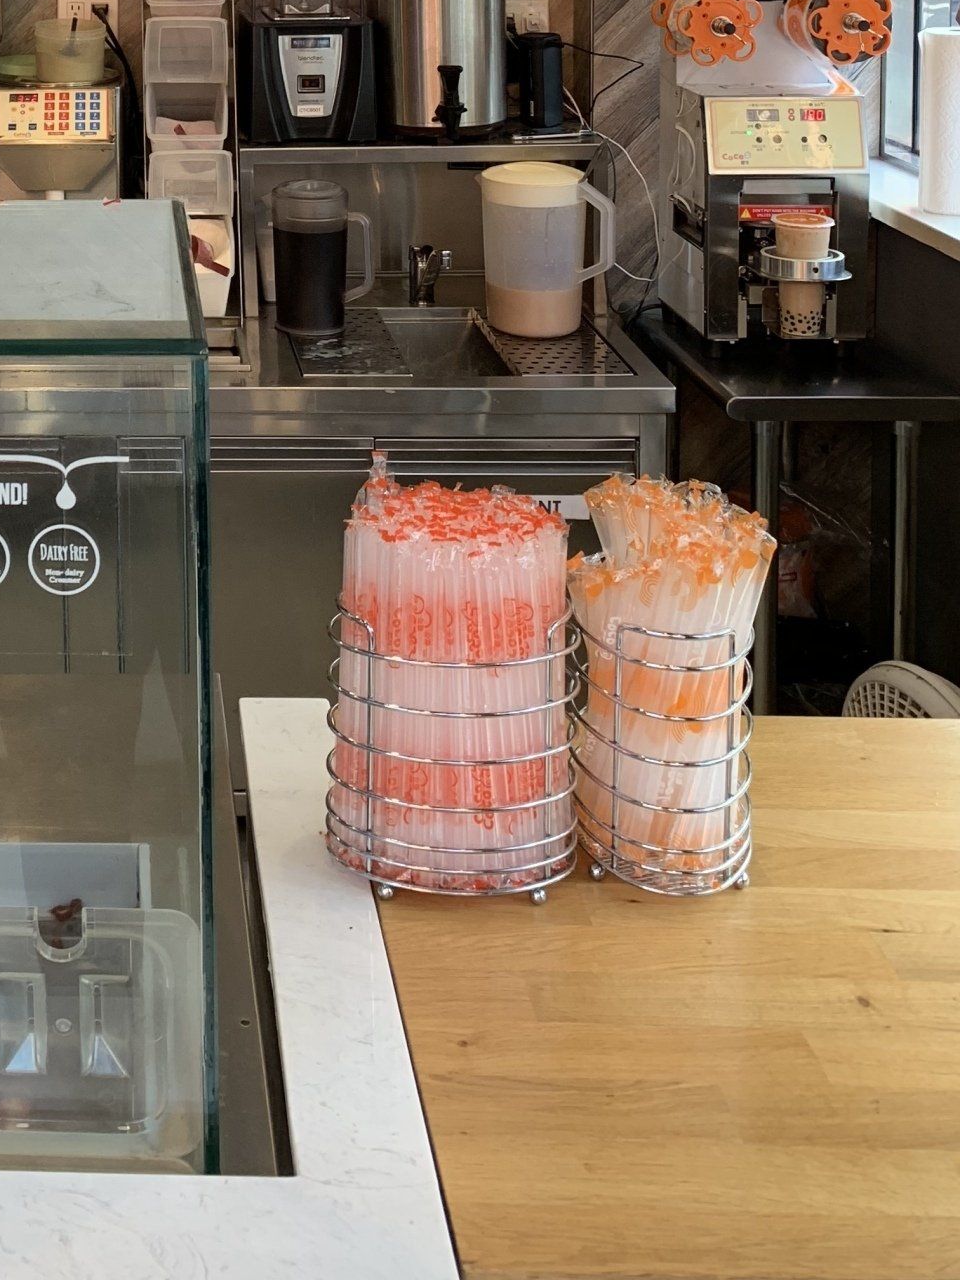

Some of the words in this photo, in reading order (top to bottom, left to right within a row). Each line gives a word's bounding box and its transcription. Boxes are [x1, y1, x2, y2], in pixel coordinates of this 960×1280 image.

[41, 544, 68, 561] DAIRY
[70, 544, 88, 561] FREE
[64, 569, 84, 577] dairy
